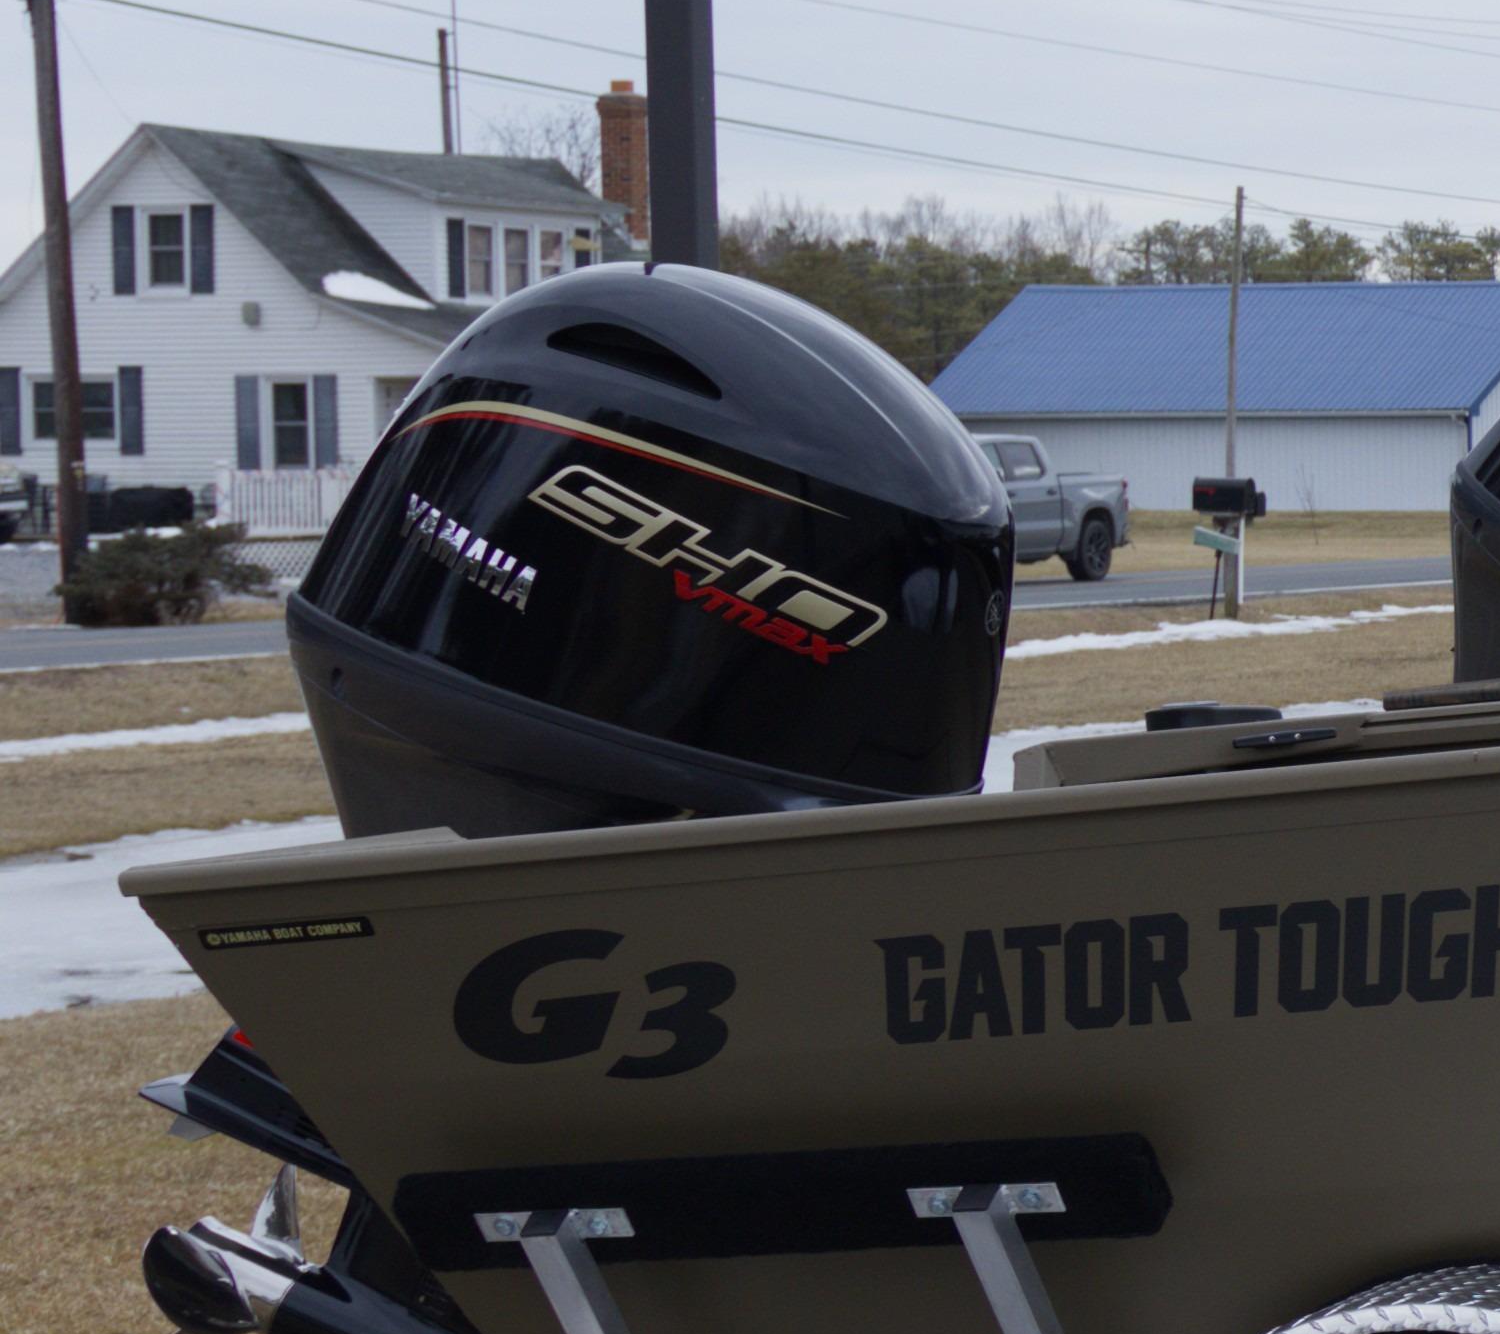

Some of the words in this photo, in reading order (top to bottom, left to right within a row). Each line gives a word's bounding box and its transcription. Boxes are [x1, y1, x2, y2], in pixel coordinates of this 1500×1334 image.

[401, 493, 537, 615] YAMAHA
[528, 465, 888, 647] SHO
[221, 930, 271, 944] YAMAHA
[272, 926, 303, 940] BOAT
[307, 922, 363, 936] COMPANY
[873, 913, 1191, 1044] GATOR
[453, 929, 737, 1079] G3
